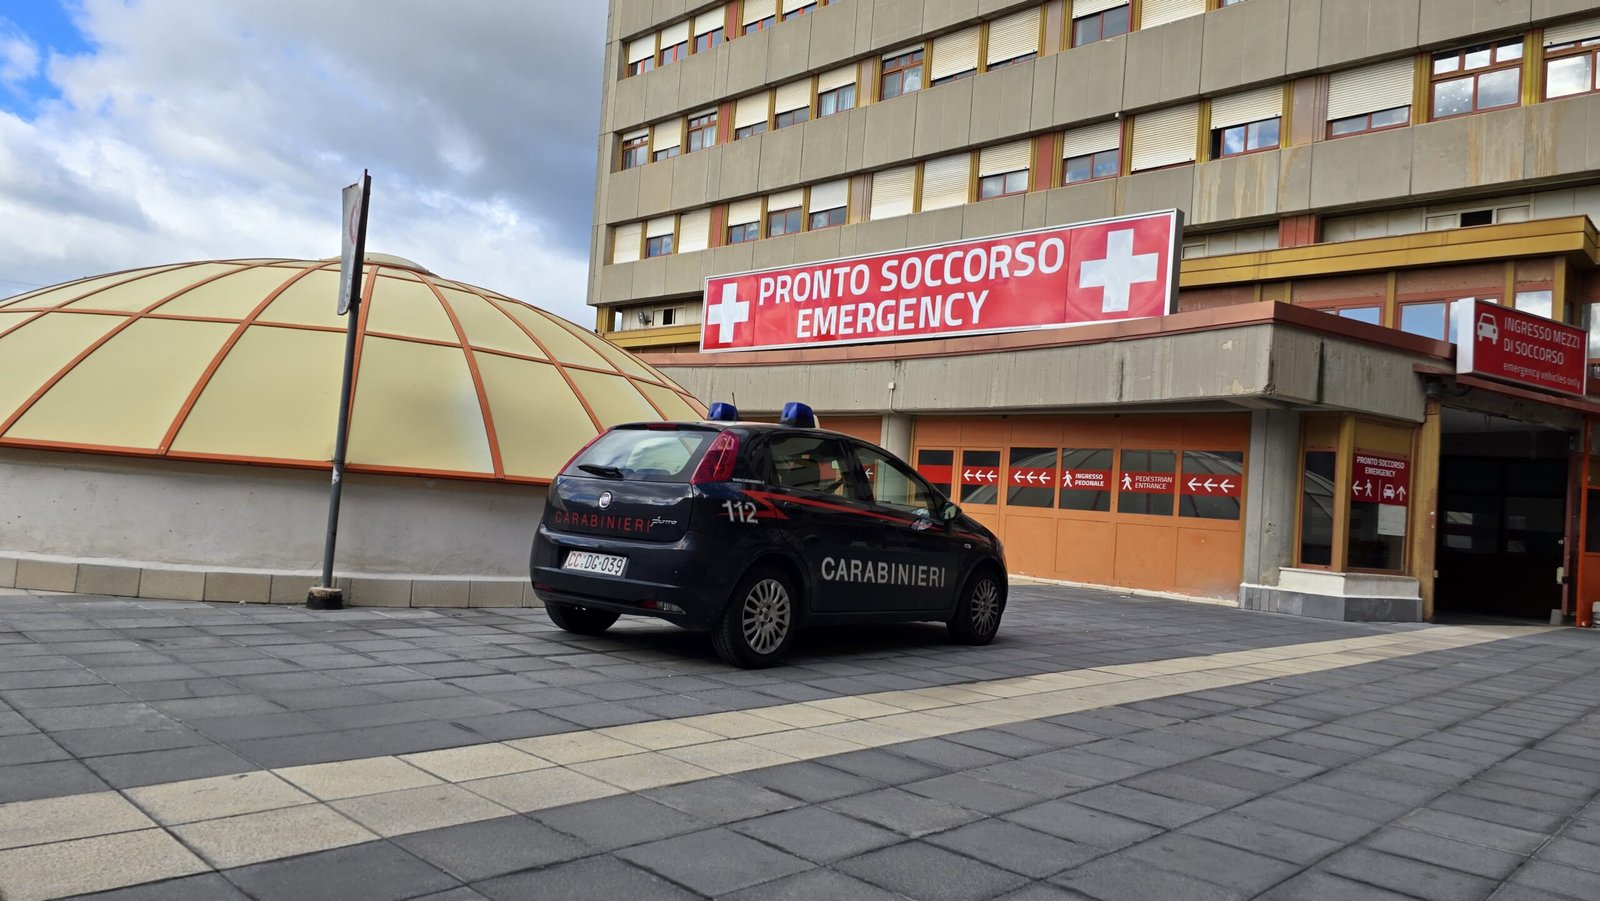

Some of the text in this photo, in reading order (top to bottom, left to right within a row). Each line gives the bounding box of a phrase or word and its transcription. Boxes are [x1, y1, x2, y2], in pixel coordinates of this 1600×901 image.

[758, 237, 1065, 305] PRONTO SOCCORSO
[796, 290, 989, 338] EMERGENCY
[1504, 317, 1580, 348] INGRESSO MEZZI
[1503, 338, 1564, 365] DI SOCCORSO
[1503, 362, 1580, 389] emergency vehicles only
[1357, 456, 1405, 469] PRONTO SOCCORSO
[1365, 467, 1396, 477] EMERGENCY
[1135, 475, 1173, 483] PEDESTRIAN
[555, 511, 650, 533] CARABINIERI
[721, 499, 759, 524] 112
[821, 556, 946, 588] CARABINIERI
